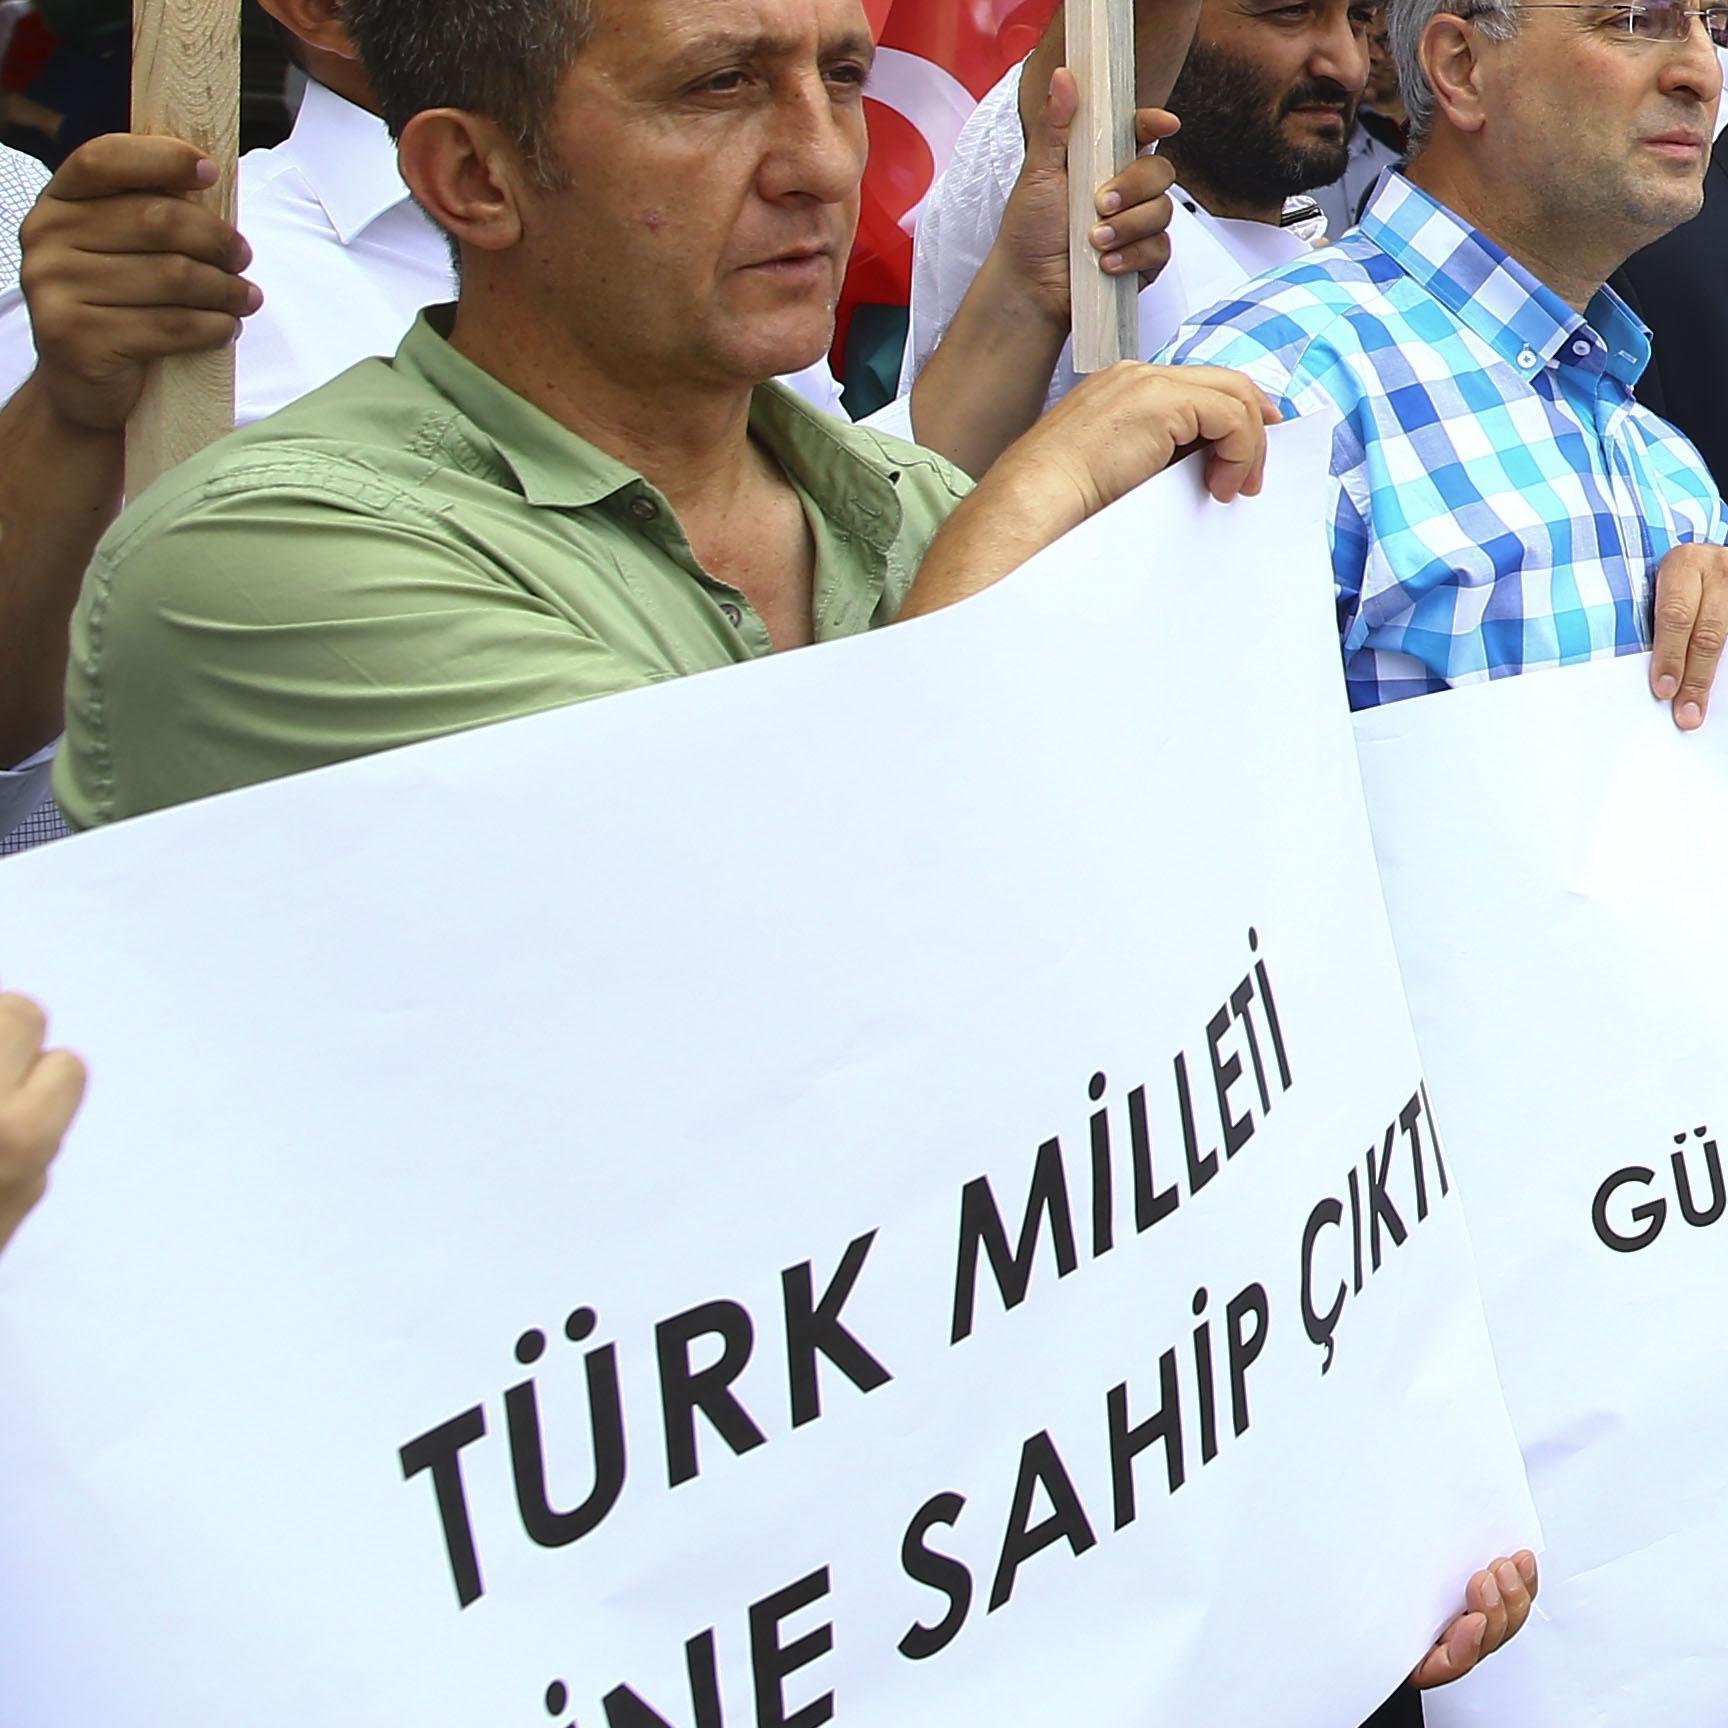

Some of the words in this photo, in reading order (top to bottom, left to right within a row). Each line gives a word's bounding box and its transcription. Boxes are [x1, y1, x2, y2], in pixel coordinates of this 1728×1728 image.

[397, 1225, 894, 1610] TÜRK
[950, 924, 1293, 1348] MİLLETİ
[896, 1280, 1269, 1663] SAHİP
[1300, 1077, 1449, 1376] ÇIKTI
